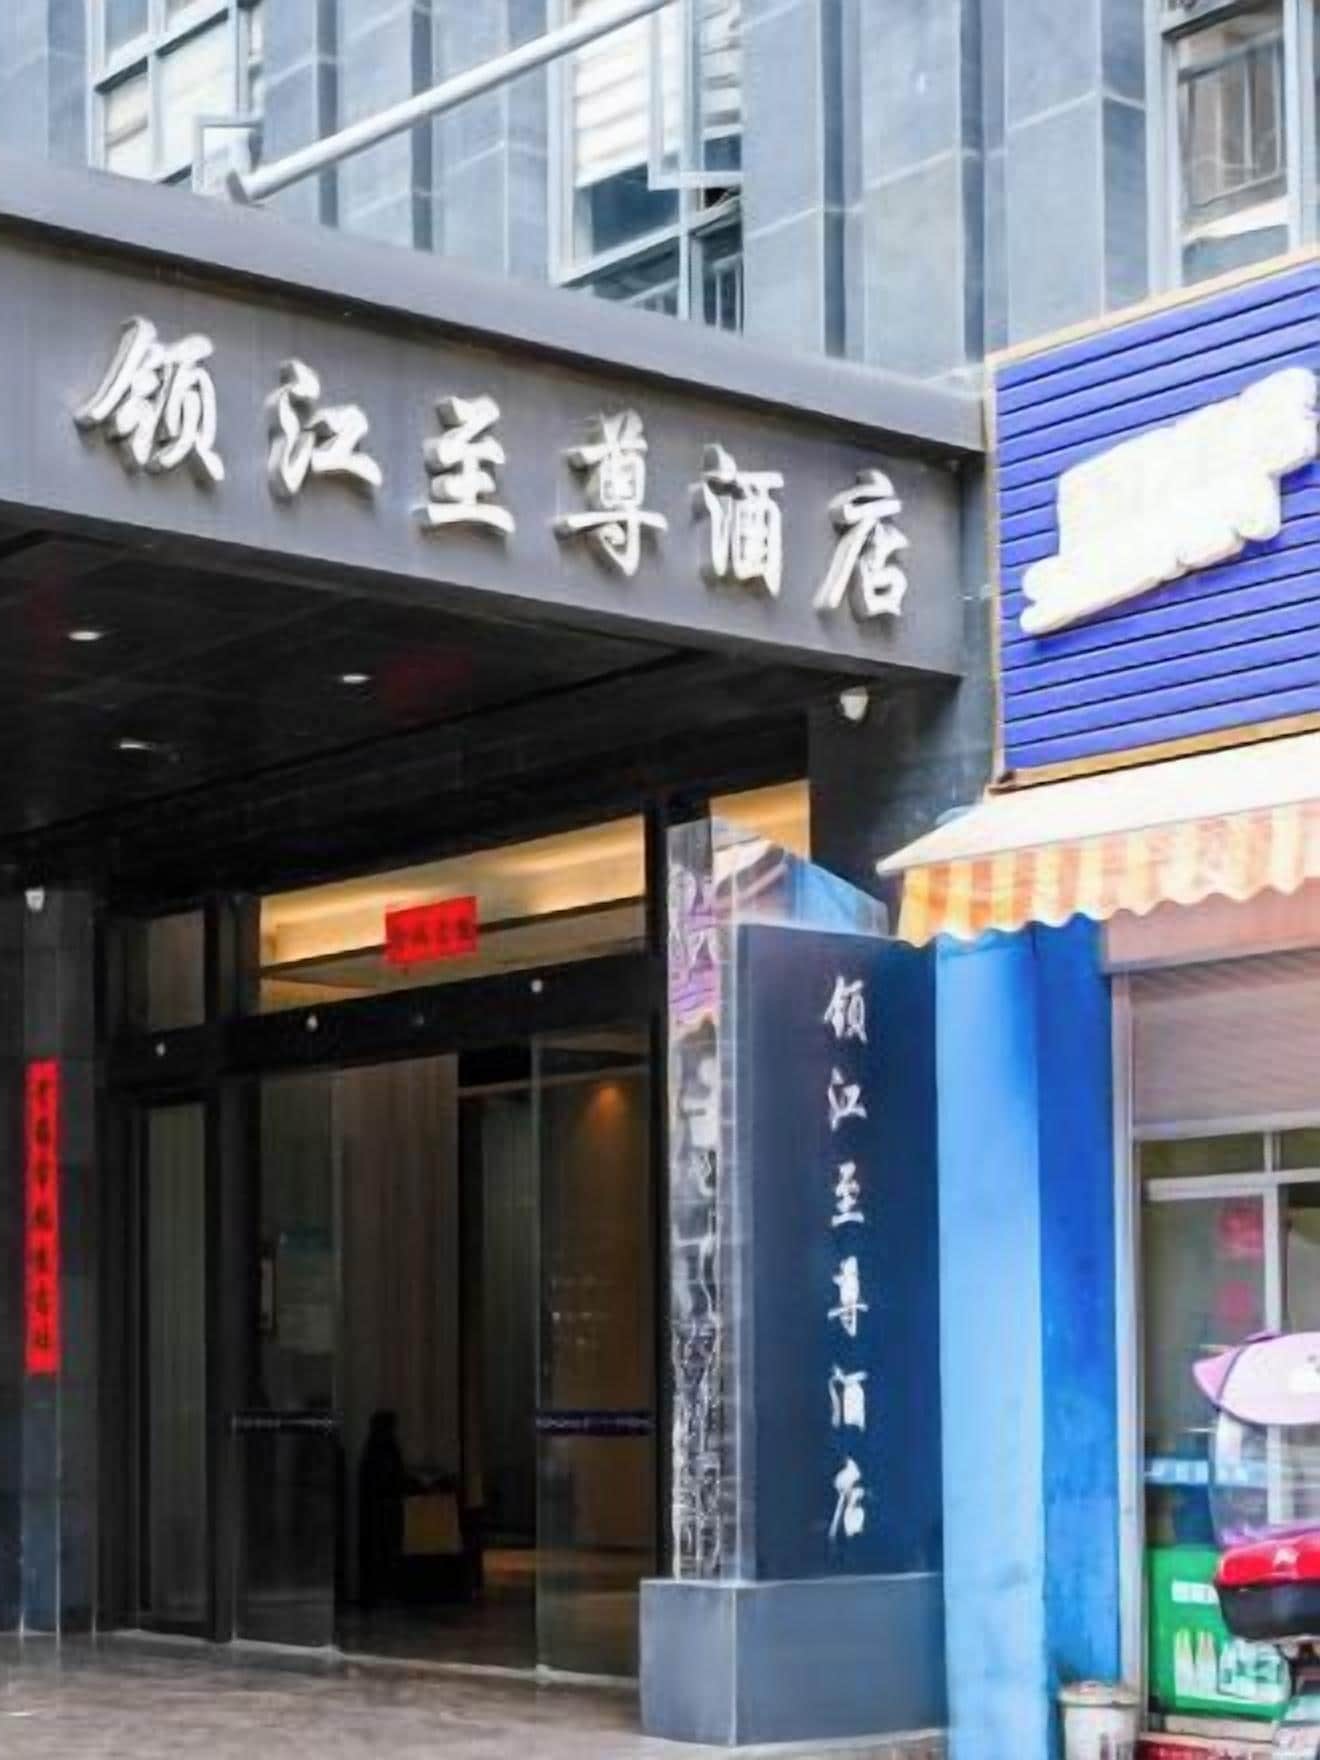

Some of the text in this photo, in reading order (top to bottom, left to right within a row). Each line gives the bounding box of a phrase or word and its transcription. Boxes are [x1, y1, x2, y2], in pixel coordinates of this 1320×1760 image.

[76, 316, 909, 618] 领江至尊酒店
[823, 975, 869, 1538] 领江至尊酒店
